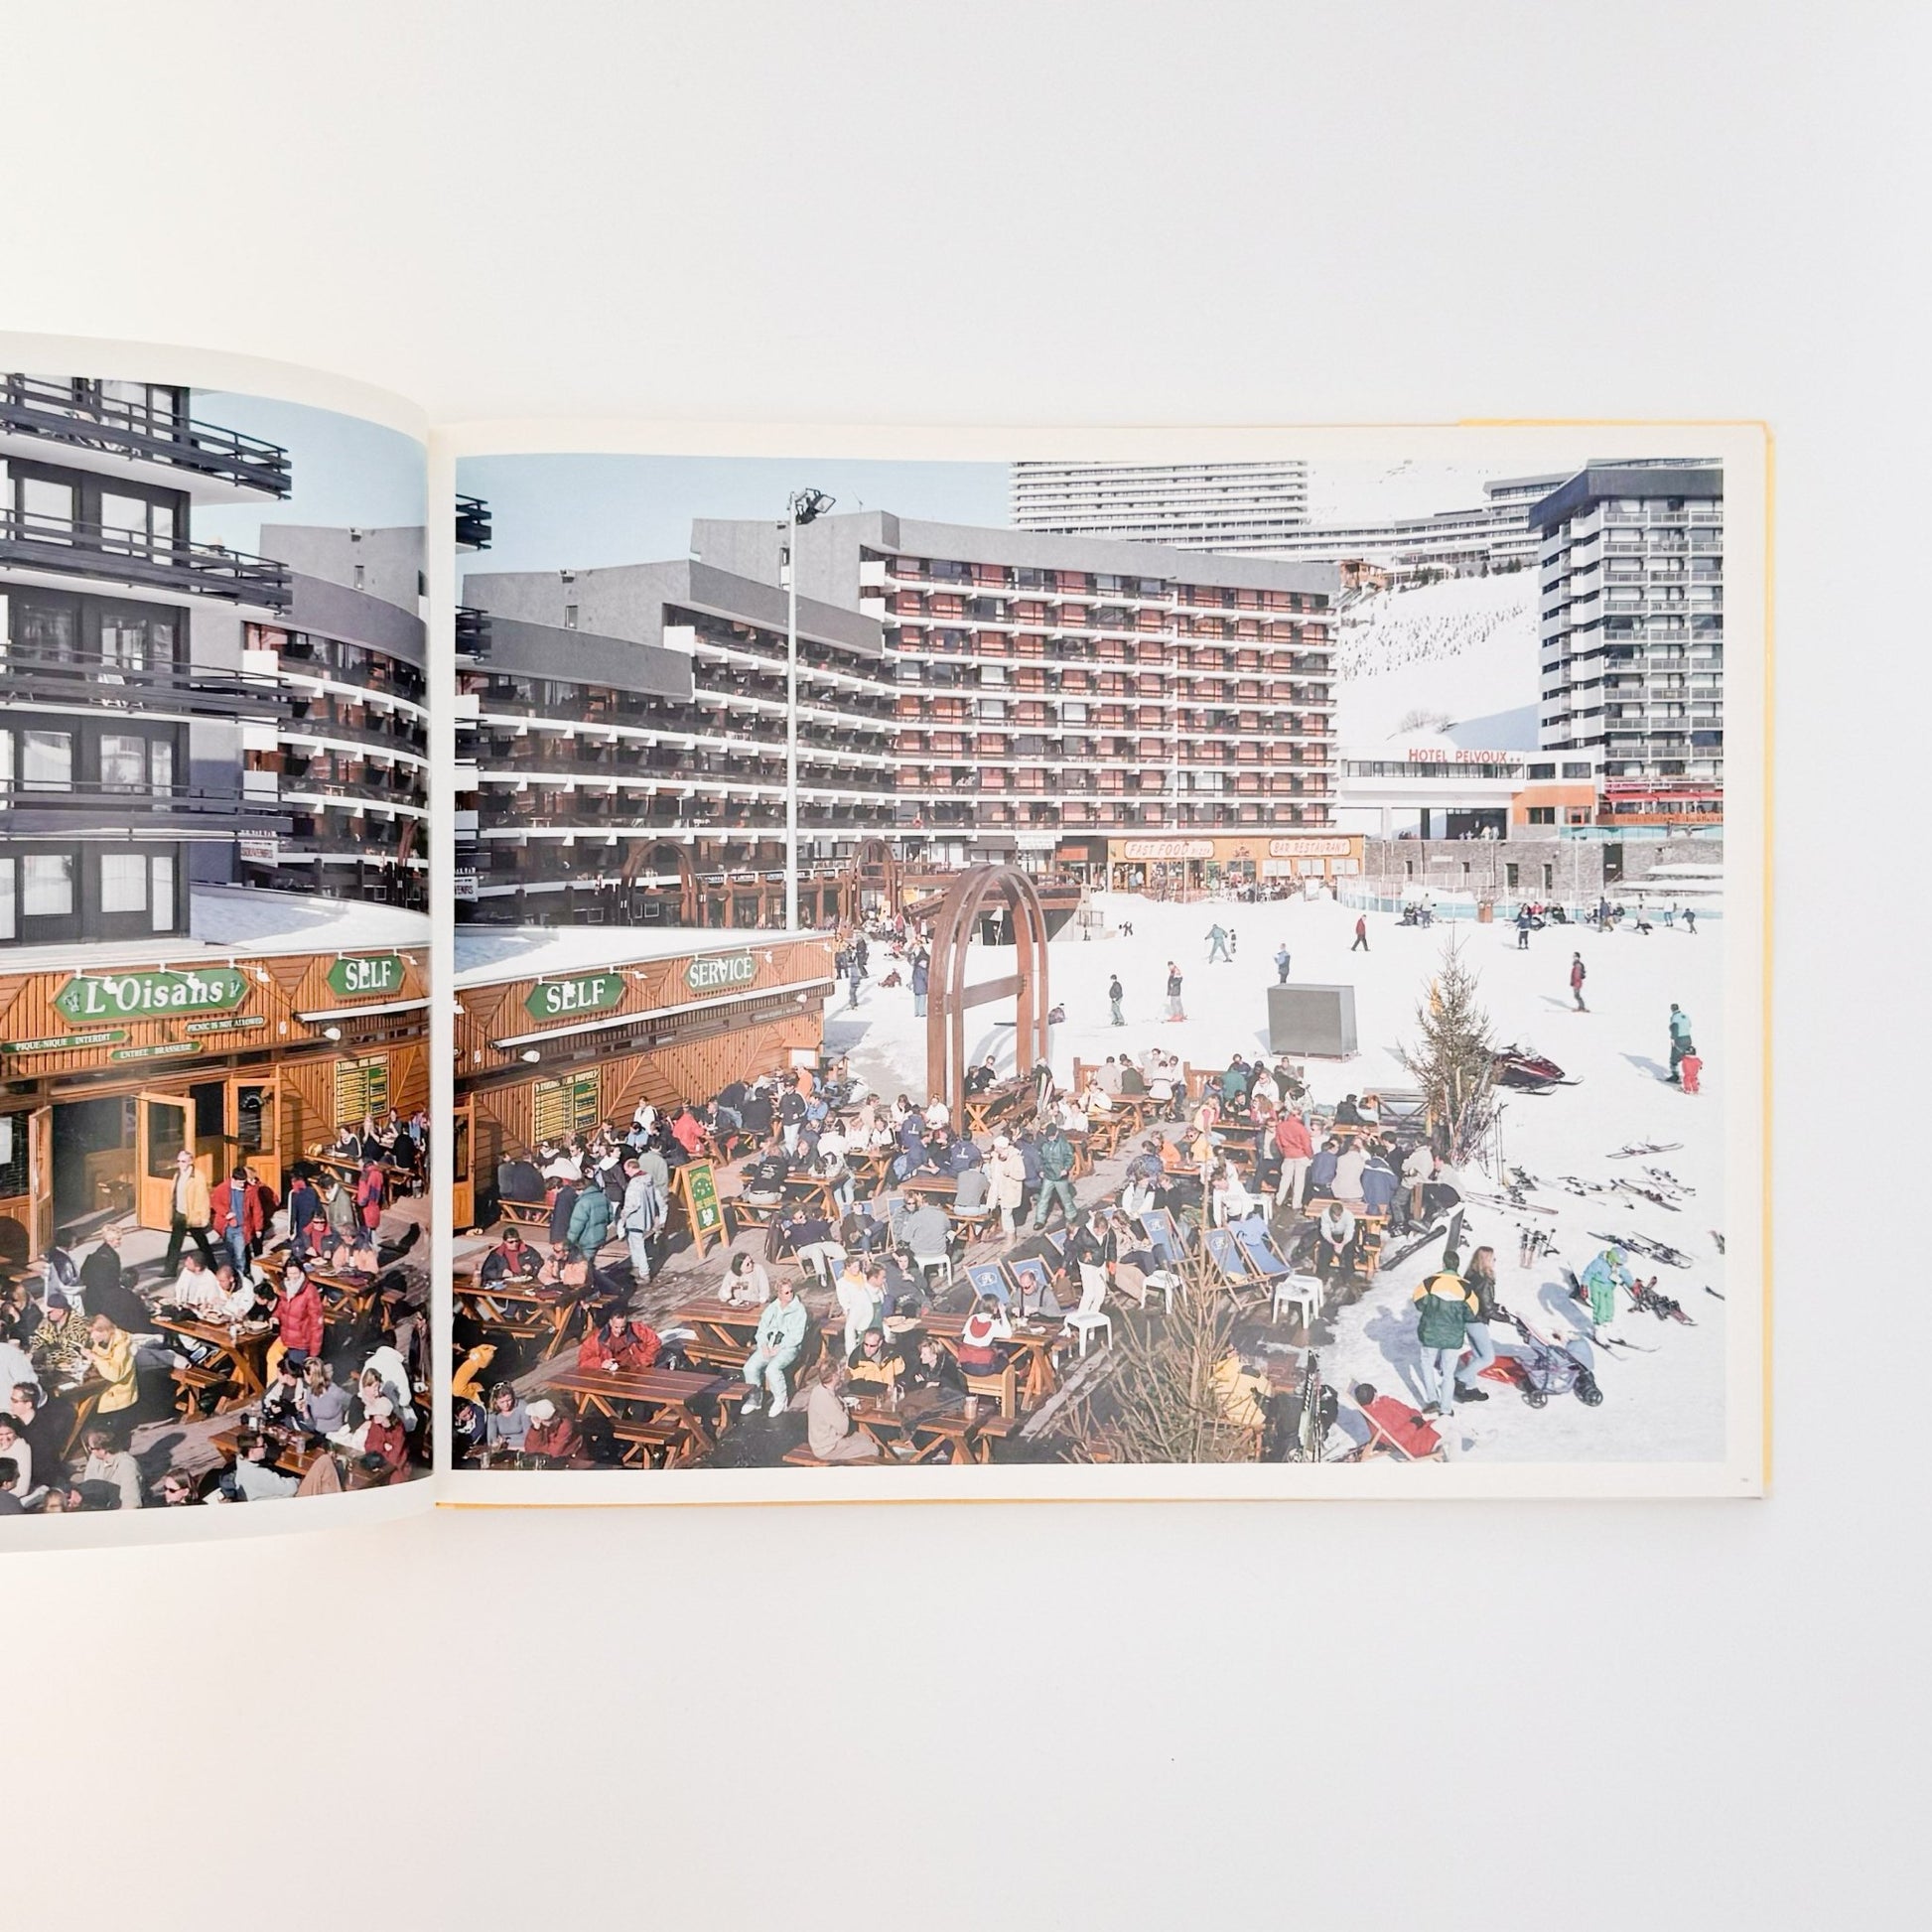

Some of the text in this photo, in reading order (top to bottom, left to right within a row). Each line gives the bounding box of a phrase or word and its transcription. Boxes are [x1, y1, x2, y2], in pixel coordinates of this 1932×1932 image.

[1409, 749, 1507, 763] HOTEL PELVOUX
[1129, 844, 1155, 856] FAST
[1159, 843, 1188, 856] FOOD
[1274, 841, 1346, 854] BAR RESTAURANT
[345, 960, 392, 991] SELF
[689, 956, 753, 988] SERVICE
[84, 977, 224, 1014] LOisans
[546, 978, 606, 1013] SELF
[15, 1033, 111, 1051] PIQUE-NIQUE INTERDIT
